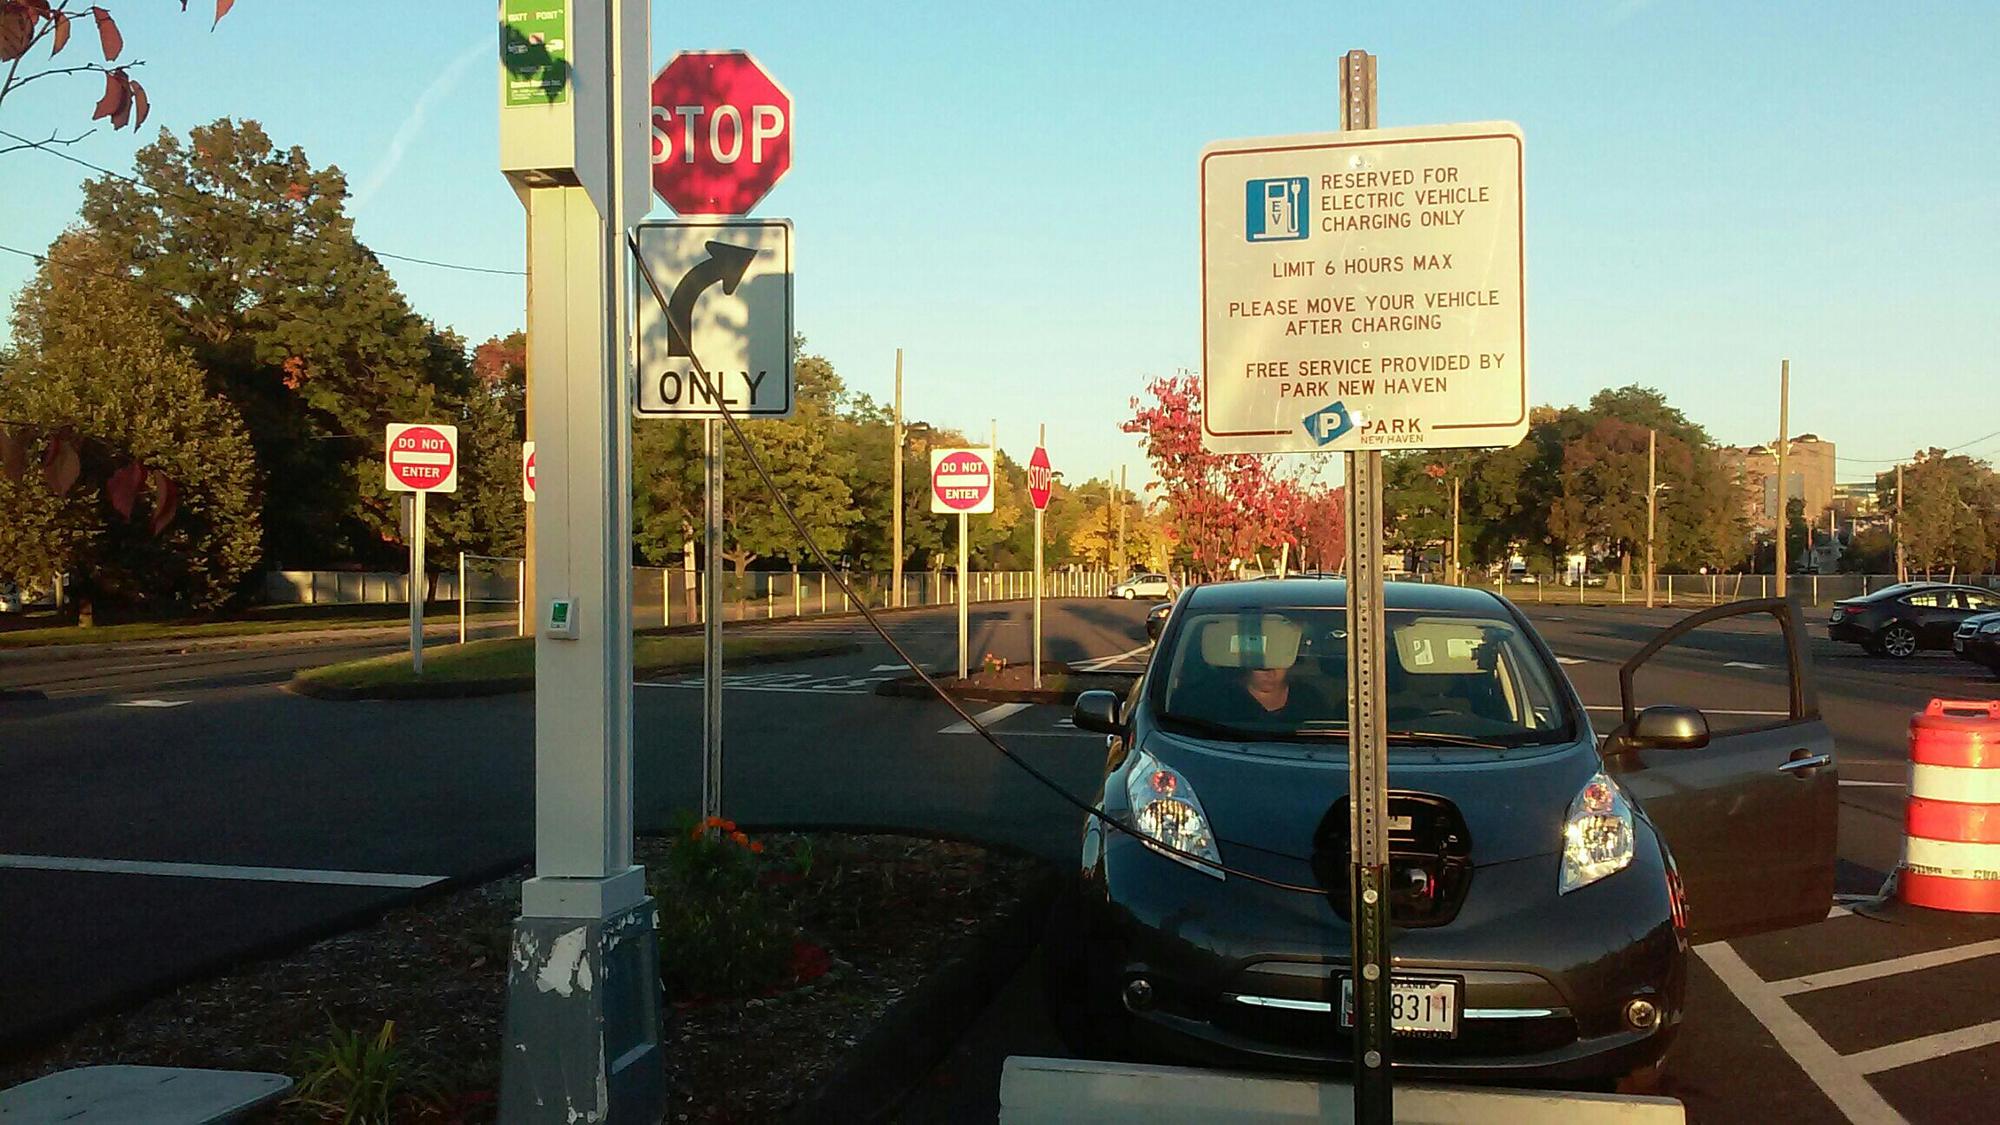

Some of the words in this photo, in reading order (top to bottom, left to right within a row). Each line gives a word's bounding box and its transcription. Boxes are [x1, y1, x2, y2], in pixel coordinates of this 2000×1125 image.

[652, 105, 785, 164] STOP
[1321, 169, 1414, 191] RESERVED
[1423, 167, 1458, 182] FOR
[1322, 192, 1405, 211] ELECTRIC
[1415, 186, 1489, 205] VEHICLE
[1322, 213, 1411, 232] CHARGING
[1421, 209, 1464, 227] ONLY
[1273, 261, 1315, 278] LIMIT
[1325, 259, 1335, 275] 6
[1345, 257, 1404, 274] HOURS
[1413, 254, 1453, 270] MAX
[1229, 300, 1298, 317] PLEASE
[1307, 296, 1356, 314] MOVE
[1365, 294, 1414, 311] YOUR
[1425, 290, 1499, 308] VEHICLE
[1285, 319, 1342, 336] AFTER
[1351, 315, 1441, 332] CHARGING
[1246, 363, 1289, 378] FREE
[1298, 358, 1372, 375] SERVICE
[1381, 355, 1470, 373] PROVIDED
[1480, 353, 1504, 369] BY
[659, 370, 767, 406] ONLY
[1280, 383, 1328, 397] PARK
[1338, 380, 1374, 395] NEW
[1384, 377, 1447, 392] HAVEN
[1361, 418, 1421, 434] PARK
[399, 438, 415, 448] DO
[422, 439, 445, 450] NOT
[1361, 435, 1385, 444] NEW
[1387, 434, 1424, 443] HAVEN
[402, 467, 440, 477] ENTER
[941, 463, 956, 472] DO
[962, 462, 983, 472] NOT
[1030, 465, 1051, 490] STOP
[945, 489, 978, 499] ENTER
[1391, 994, 1446, 1023] 8311
